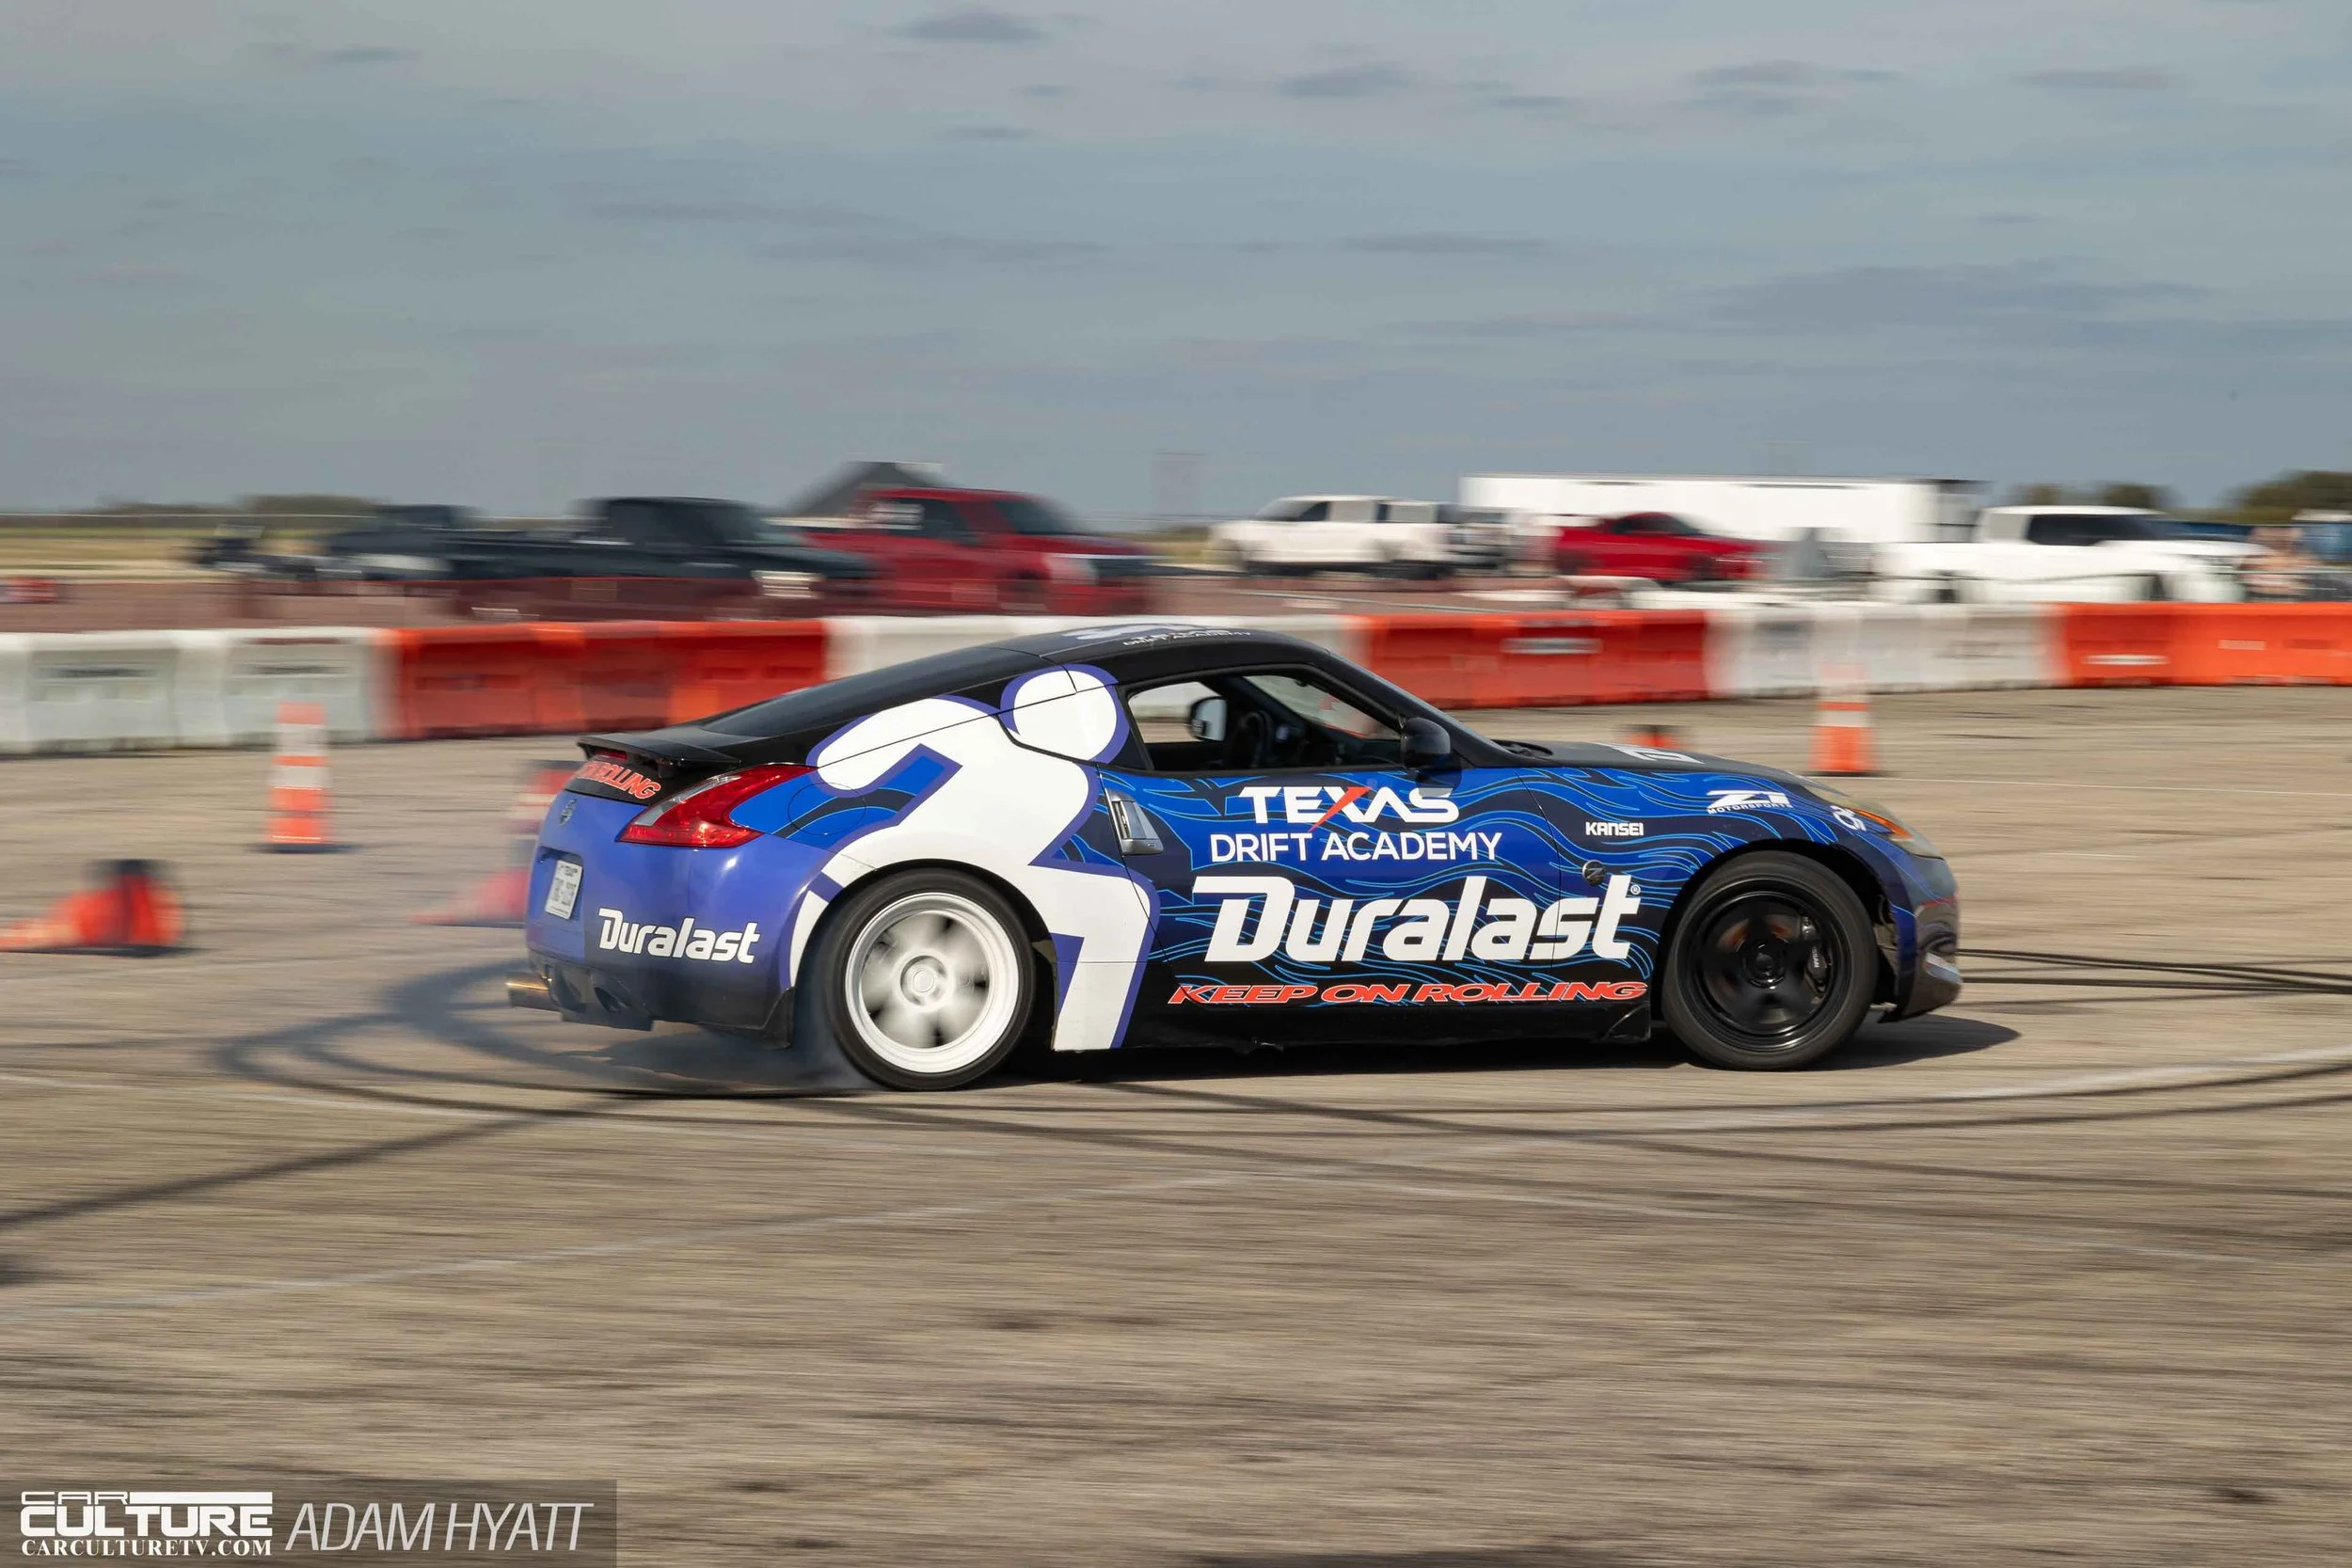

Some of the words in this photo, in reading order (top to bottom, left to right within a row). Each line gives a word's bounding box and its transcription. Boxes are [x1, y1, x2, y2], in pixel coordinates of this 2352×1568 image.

[1238, 786, 1459, 832] TEXAS
[1585, 821, 1645, 836] KANSEI
[1210, 832, 1313, 863] DRIFT
[1321, 832, 1502, 861] ACADEMY
[598, 908, 760, 964] Duralast
[1168, 983, 1319, 1004] KEEP
[1320, 982, 1412, 1003] ON
[1413, 981, 1648, 1003] ROLLING
